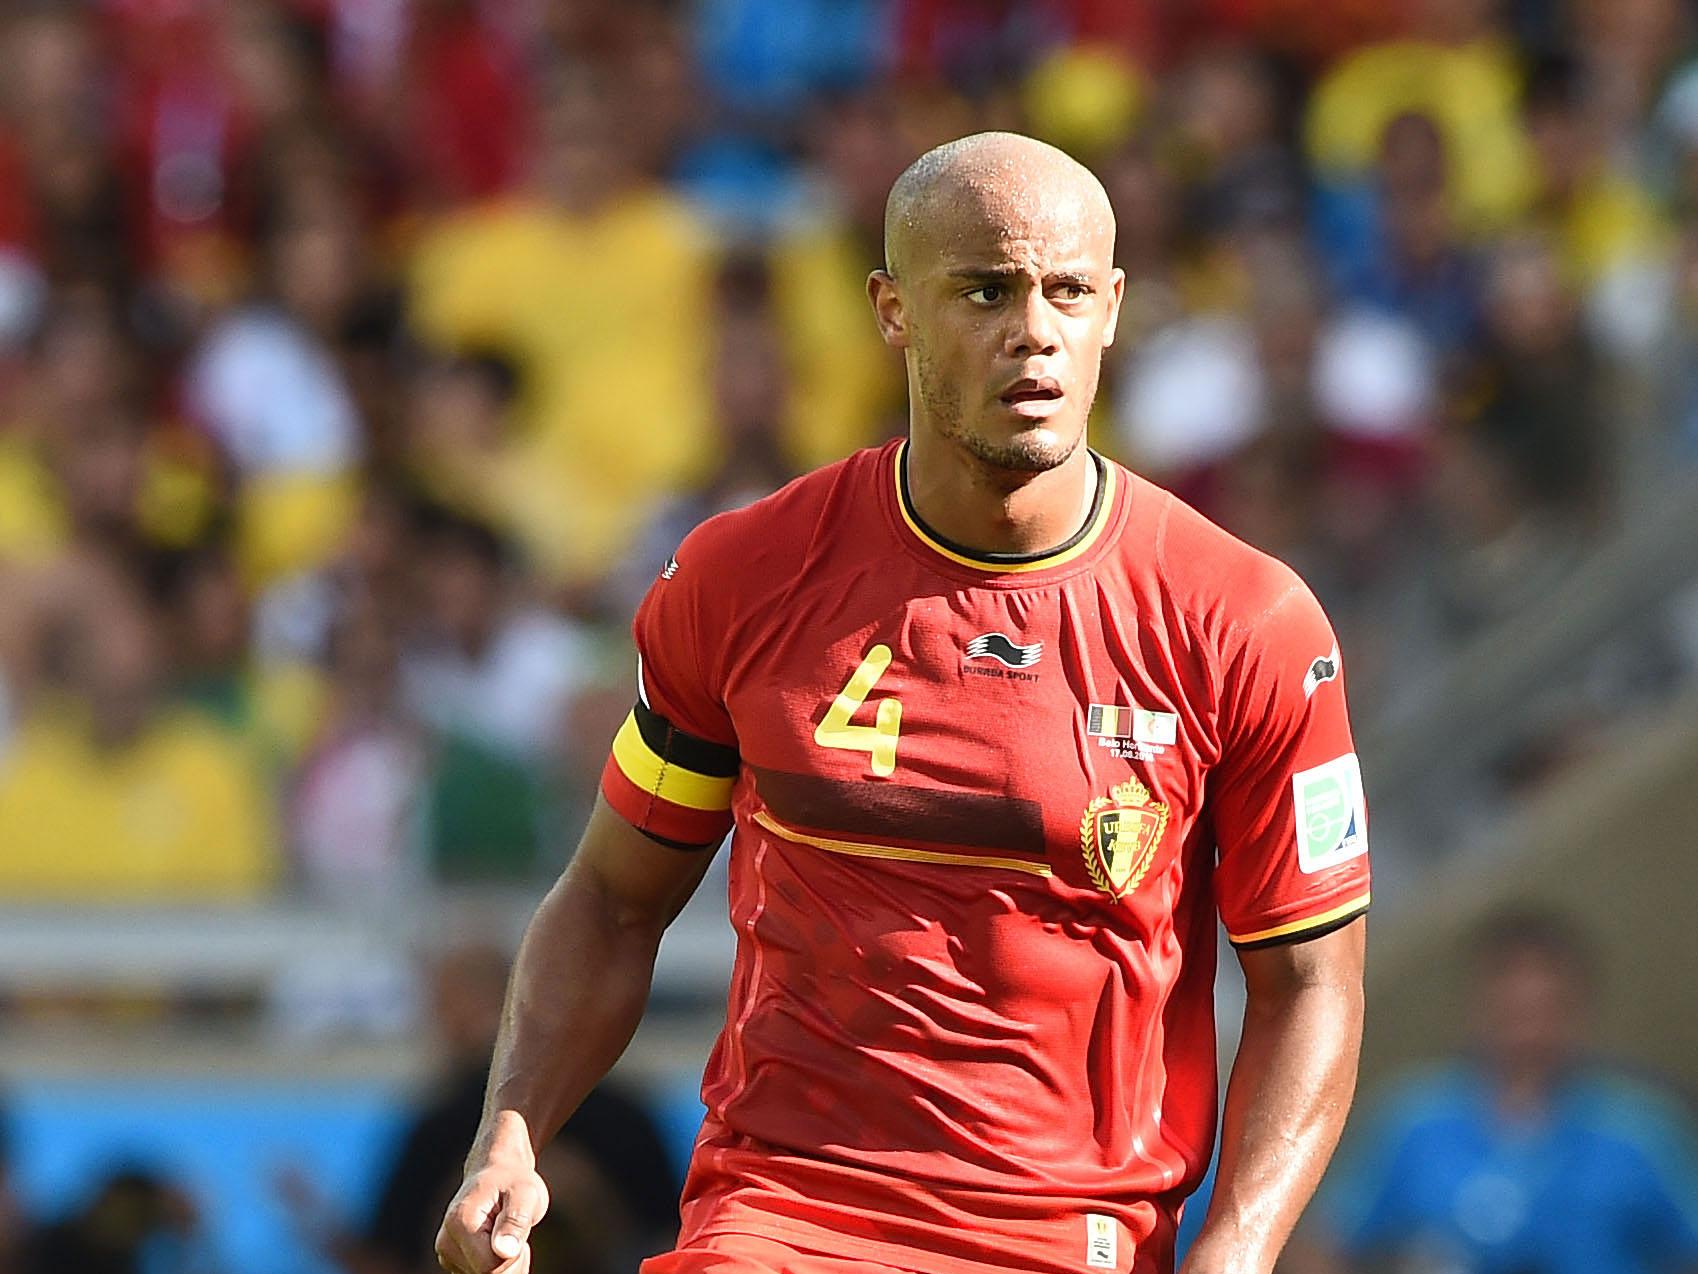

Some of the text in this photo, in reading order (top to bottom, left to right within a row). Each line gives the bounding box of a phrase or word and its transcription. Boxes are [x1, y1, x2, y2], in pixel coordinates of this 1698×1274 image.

[1007, 670, 1039, 682] SPORT
[813, 644, 903, 777] 4
[1098, 737, 1120, 748] Belo
